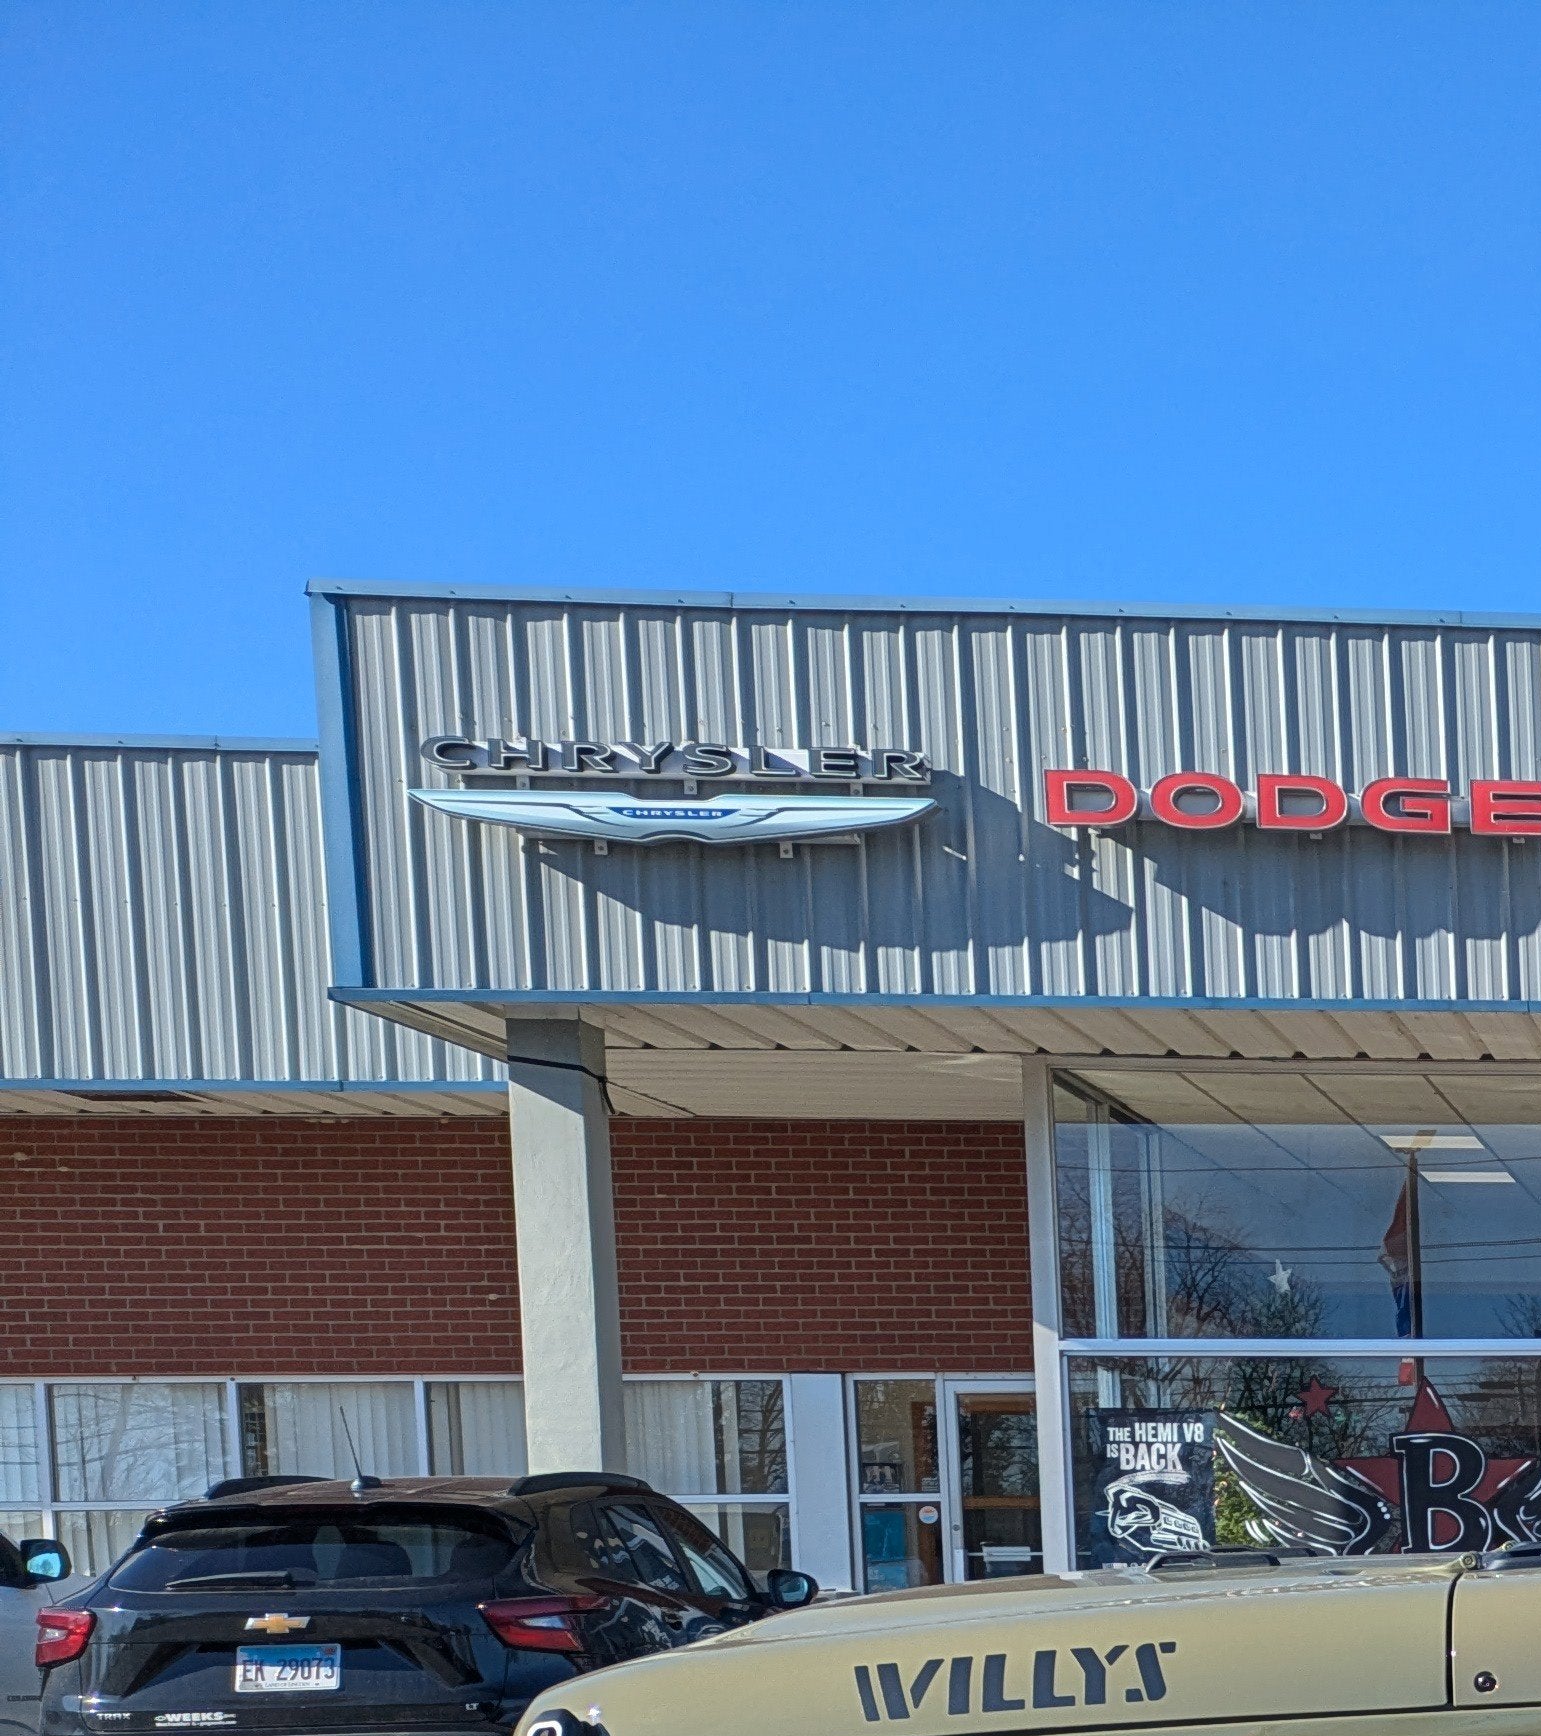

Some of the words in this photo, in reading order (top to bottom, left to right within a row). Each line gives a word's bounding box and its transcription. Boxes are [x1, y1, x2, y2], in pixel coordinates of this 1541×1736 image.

[420, 734, 932, 781] CHRYSLER
[622, 809, 722, 817] CHRYSLER
[1106, 1427, 1132, 1442] THE
[1134, 1422, 1179, 1443] HEMI
[1182, 1422, 1205, 1443] V8
[1106, 1443, 1119, 1458] IS
[1119, 1443, 1183, 1471] BACK
[242, 1659, 266, 1682] EK
[276, 1657, 335, 1681] 29073
[853, 1641, 1177, 1722] WILLYS
[96, 1712, 131, 1721] TRAX
[164, 1711, 224, 1722] WEEKS
